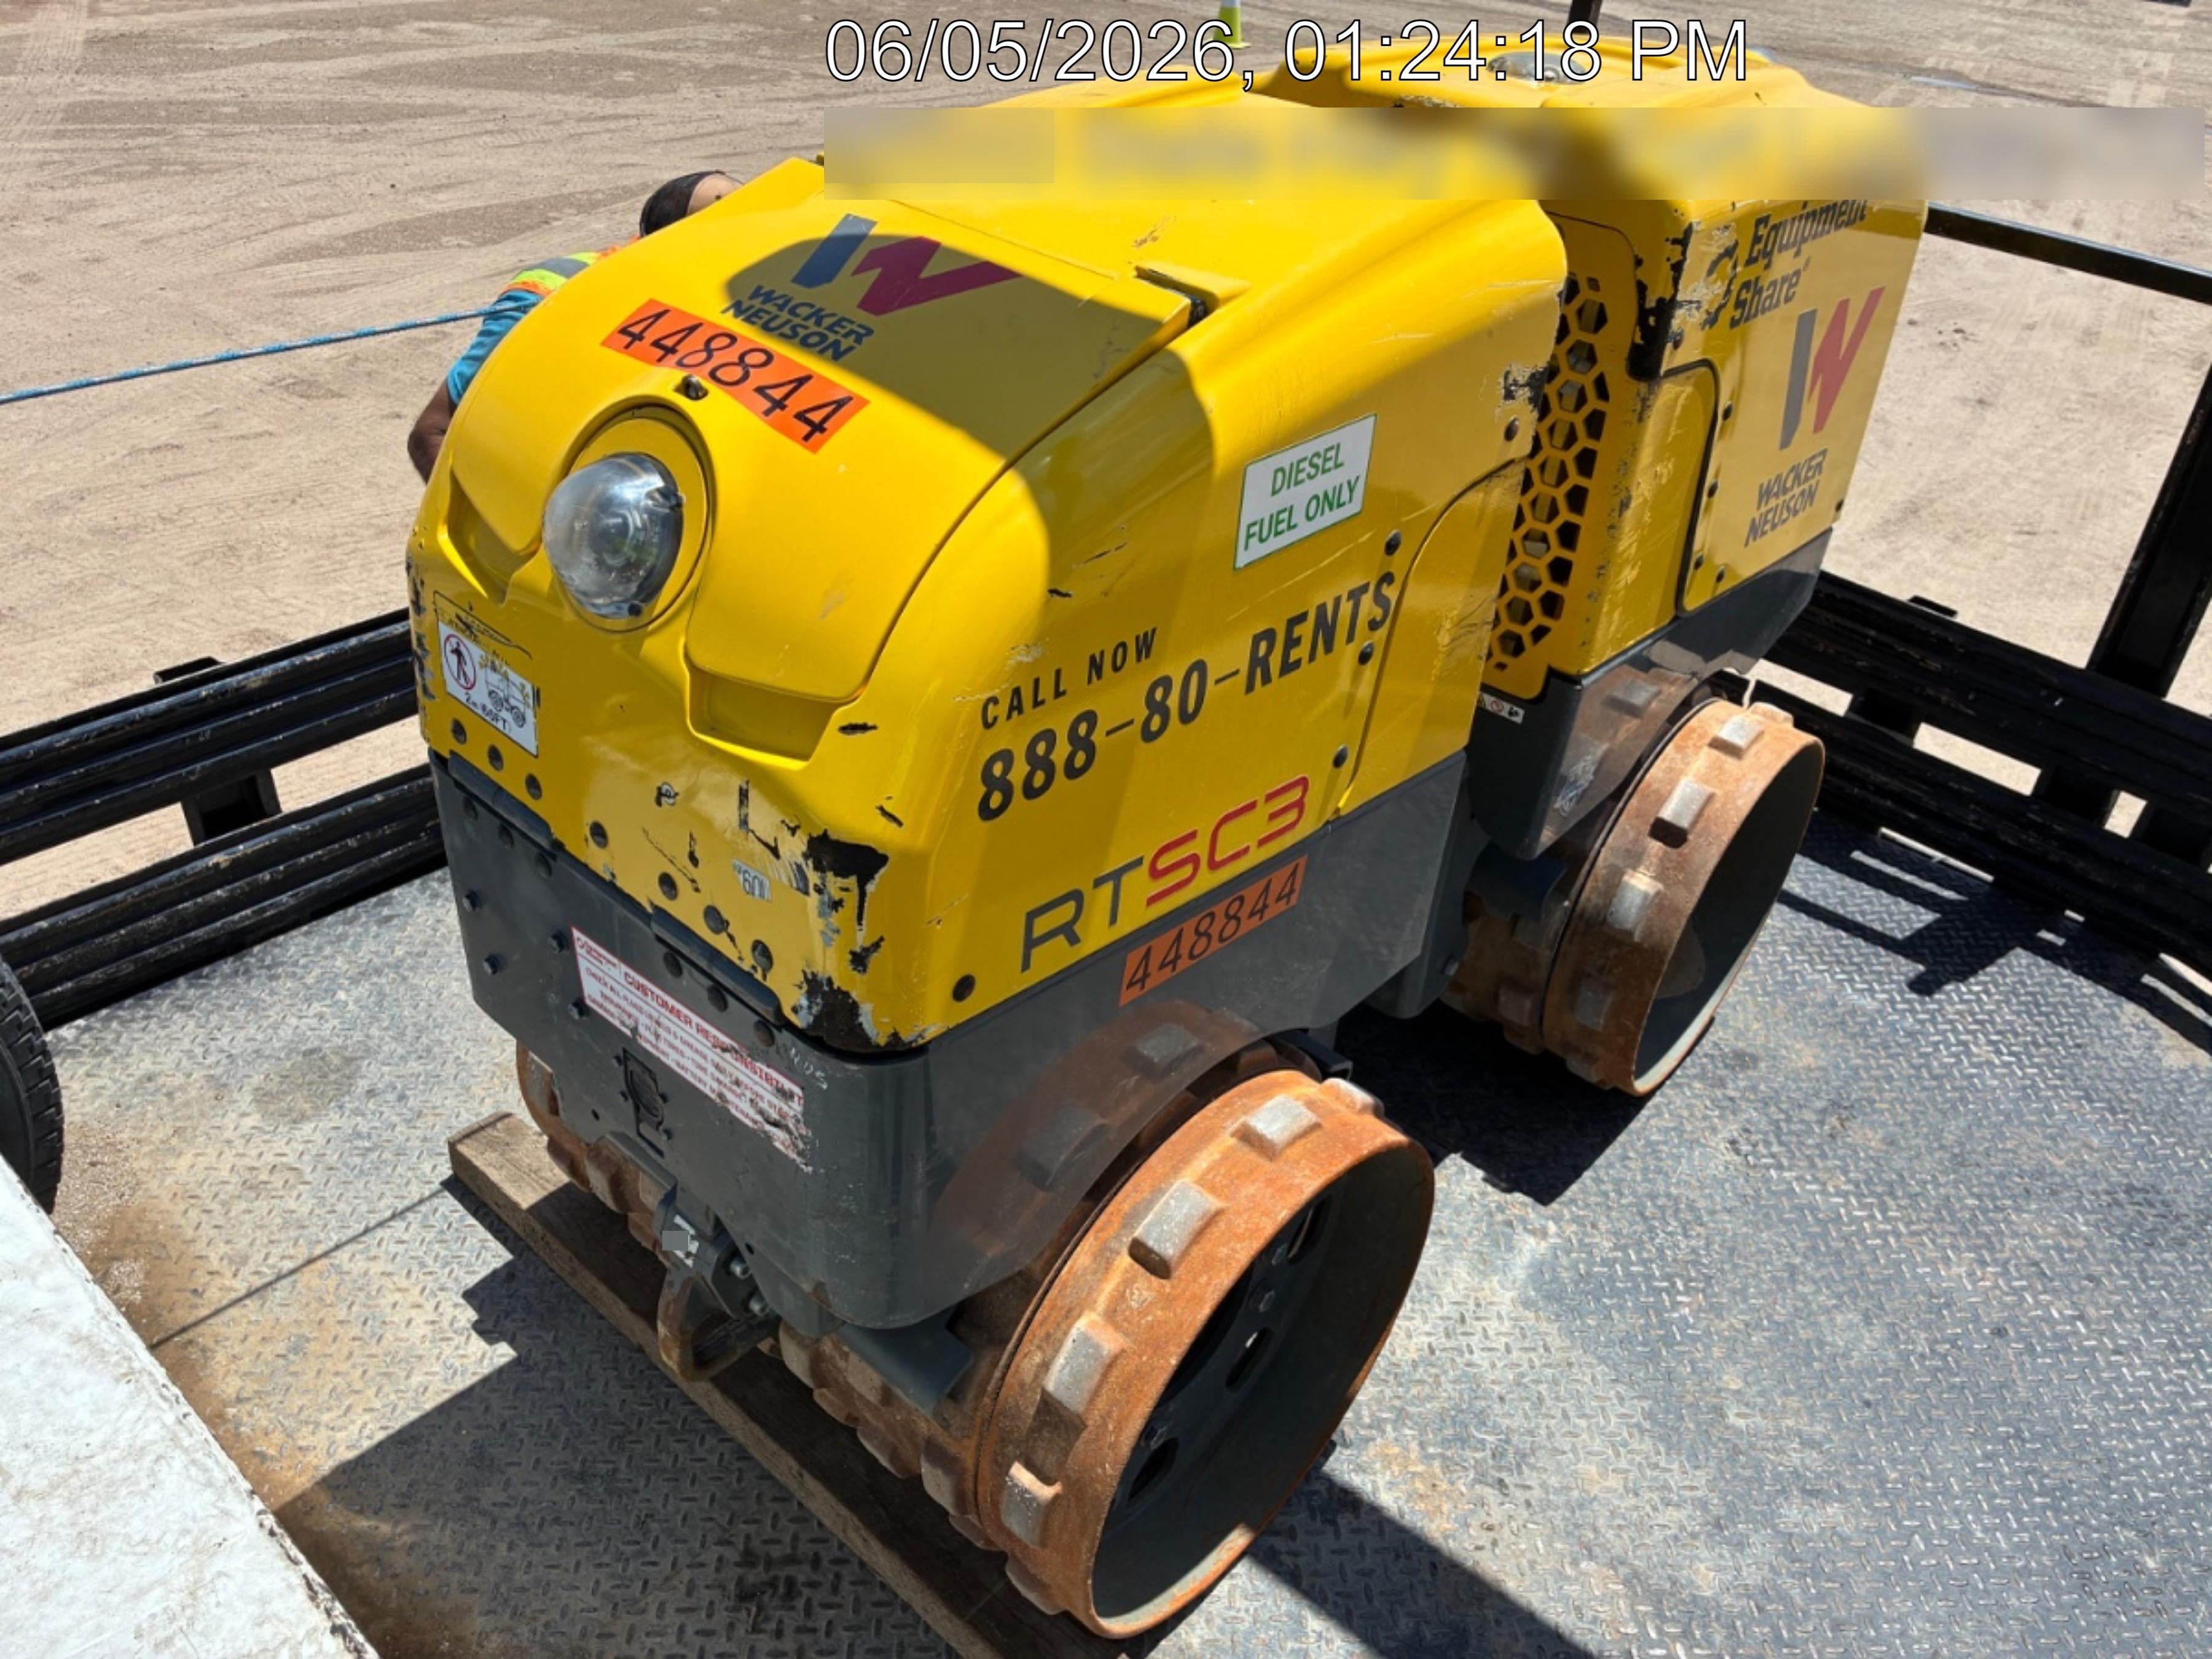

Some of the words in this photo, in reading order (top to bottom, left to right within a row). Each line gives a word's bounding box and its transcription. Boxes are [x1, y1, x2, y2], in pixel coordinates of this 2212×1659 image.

[1744, 200, 1868, 270] Equipment
[720, 299, 857, 361] NEUSON
[748, 284, 874, 345] WACKER
[1729, 268, 1802, 329] Share
[617, 309, 854, 442] 448844
[1270, 442, 1344, 497] DIESEL
[1756, 447, 1827, 511] WACKER
[1244, 504, 1298, 552] FUEL
[1304, 475, 1360, 522] ONLY
[1744, 482, 1819, 547] NEUSON
[978, 570, 1395, 822] 888-80-RENTS
[981, 667, 1068, 730] CALL
[1086, 627, 1158, 685] NOW
[1021, 774, 1310, 974] RTSC3
[1126, 862, 1300, 992] 448844
[624, 971, 696, 1030] CUSTOMER
